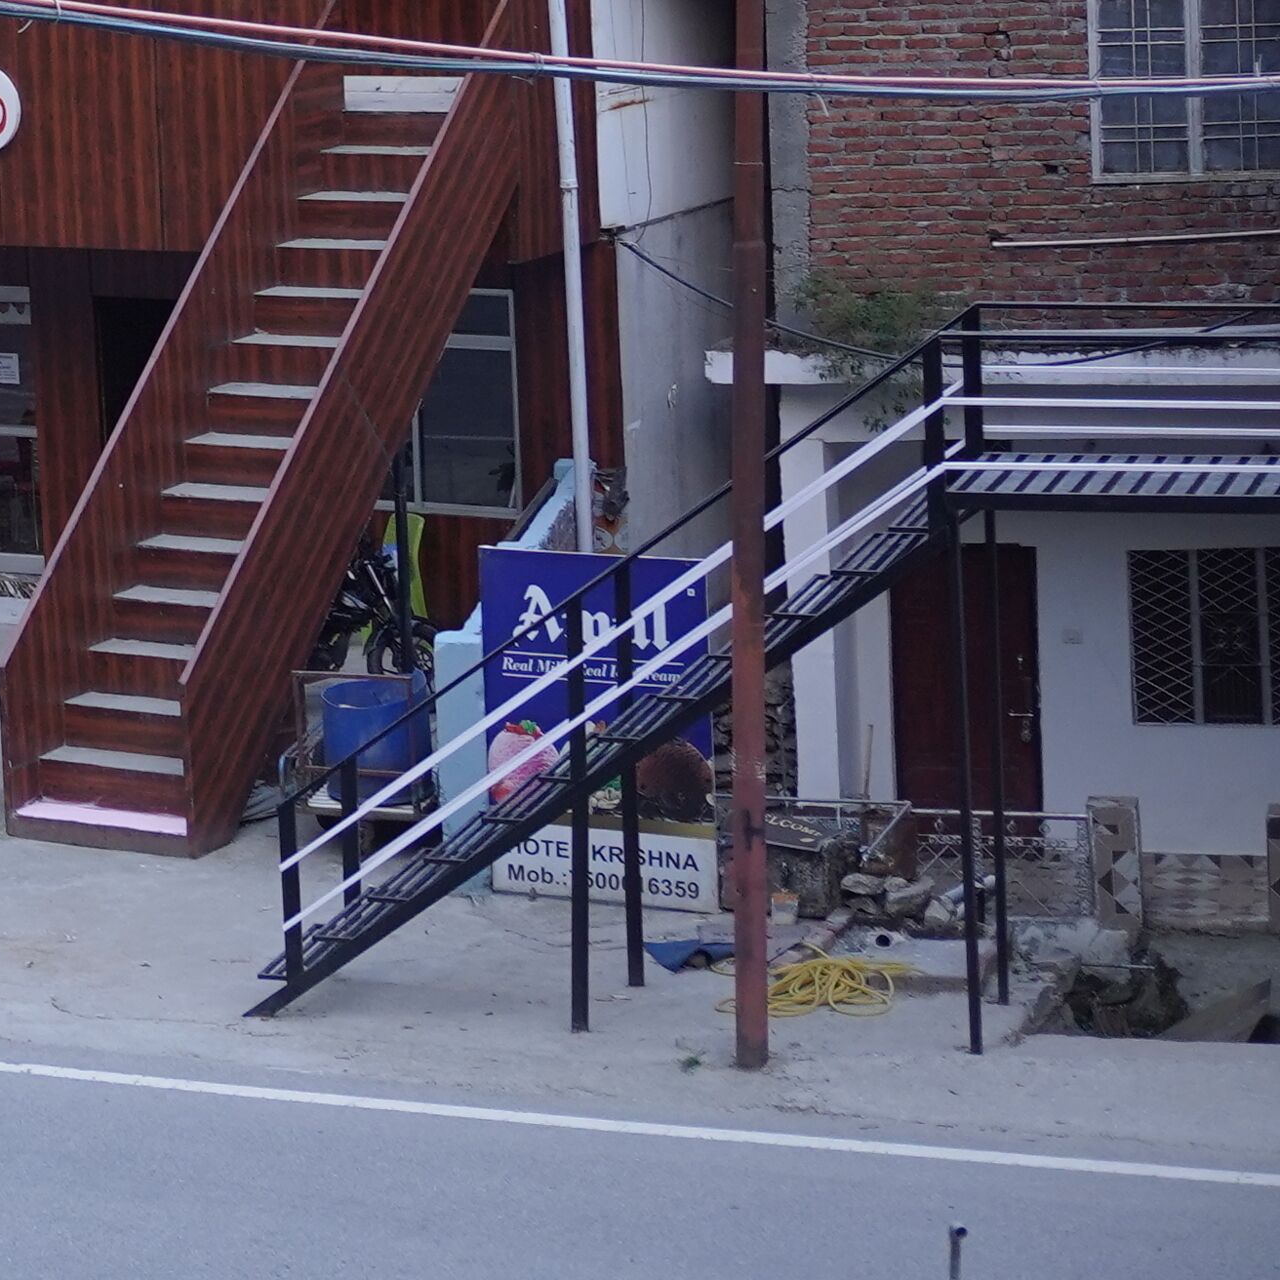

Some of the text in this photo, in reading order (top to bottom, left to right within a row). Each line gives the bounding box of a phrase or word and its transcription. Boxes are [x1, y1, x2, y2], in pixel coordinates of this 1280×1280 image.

[502, 656, 534, 672] Real
[582, 663, 609, 678] eal
[509, 837, 700, 872] OTE KRSHNA
